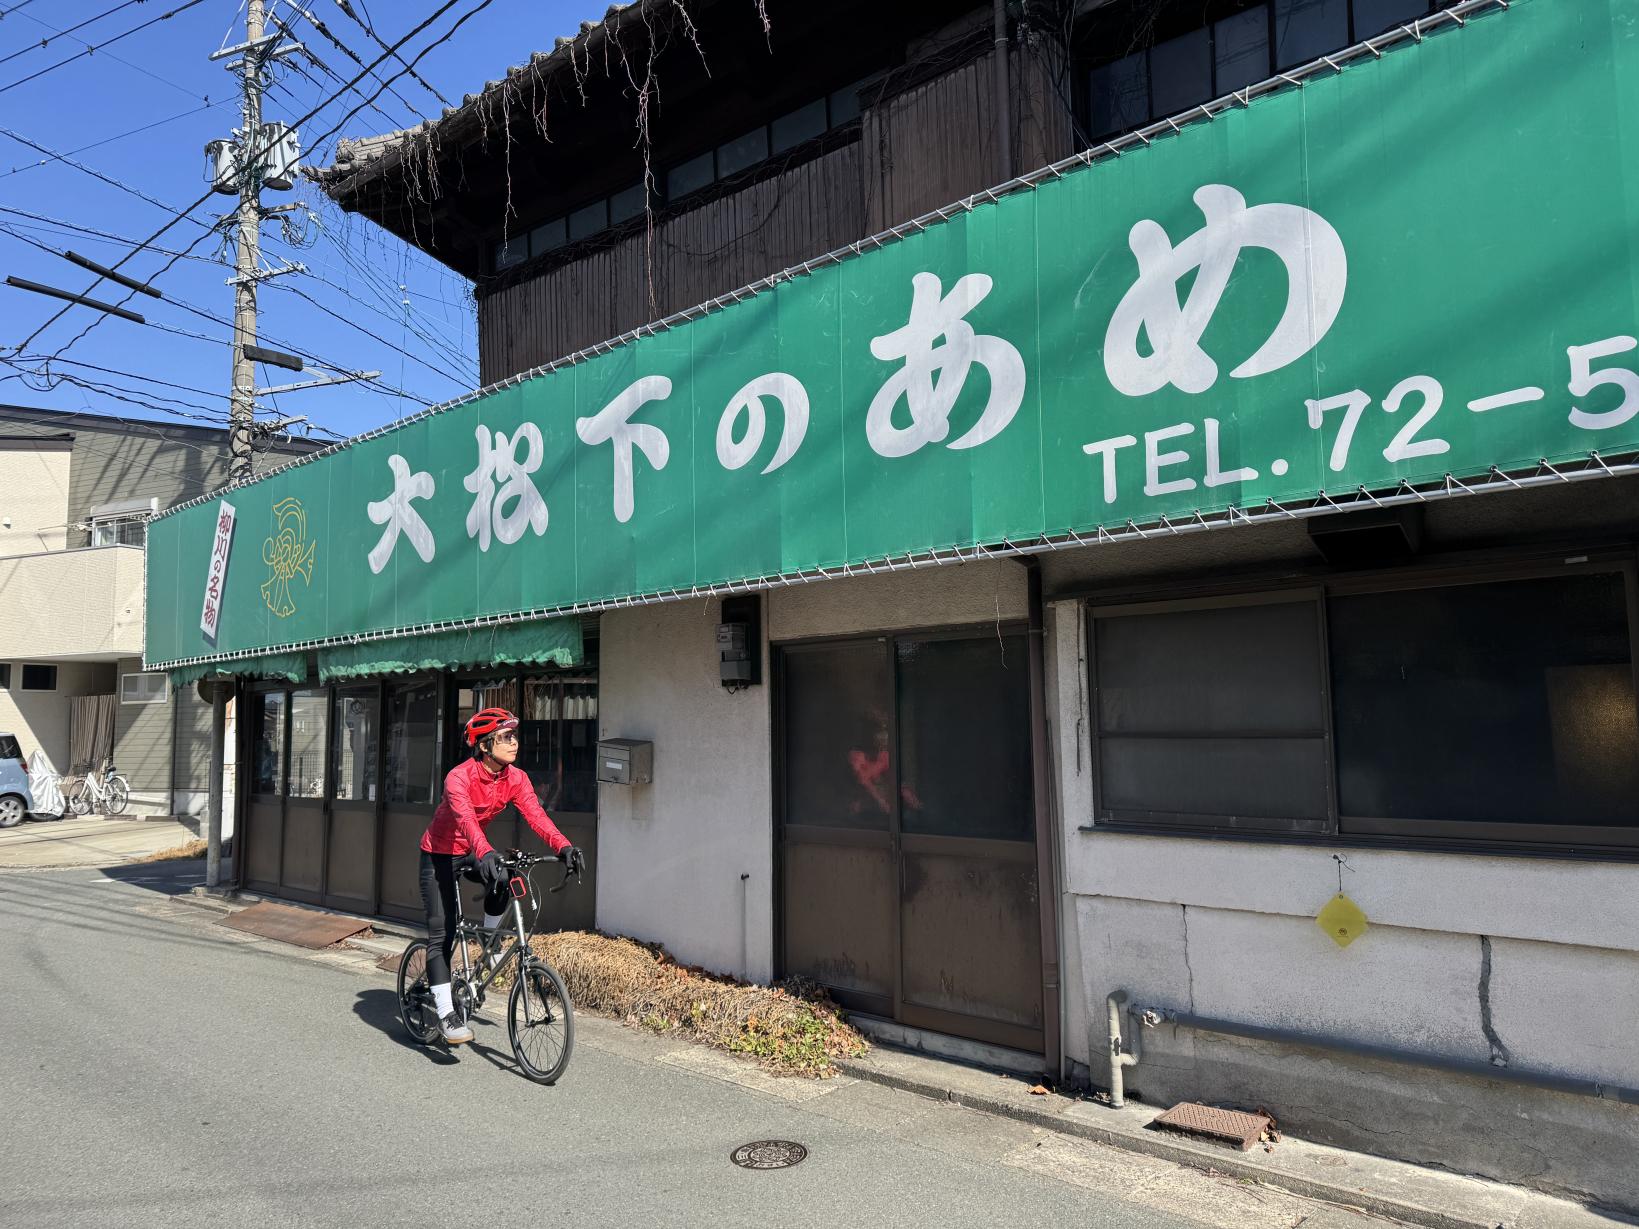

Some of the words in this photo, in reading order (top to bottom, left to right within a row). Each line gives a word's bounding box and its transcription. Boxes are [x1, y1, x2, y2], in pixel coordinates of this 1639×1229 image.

[1083, 418, 1289, 504] TEL.
[204, 509, 232, 629] 柳川の名物
